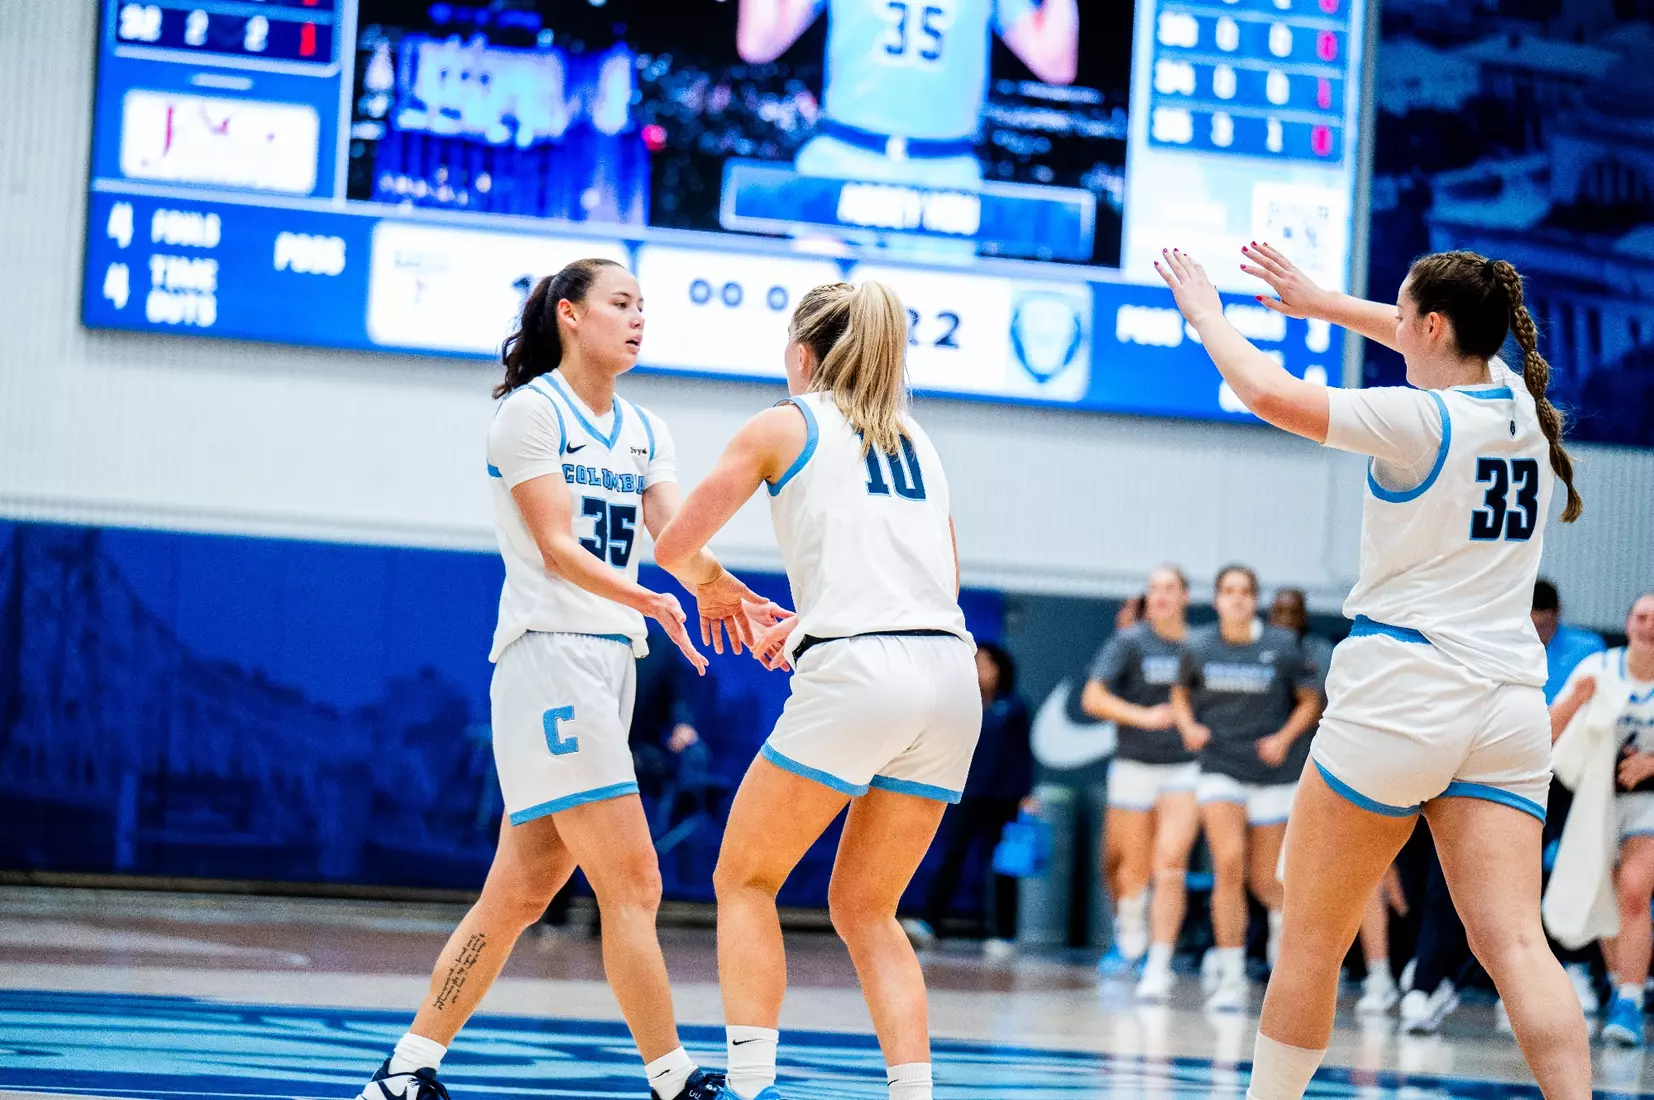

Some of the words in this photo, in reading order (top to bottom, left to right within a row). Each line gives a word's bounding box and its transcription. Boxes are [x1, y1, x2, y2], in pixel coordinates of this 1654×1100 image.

[884, 1, 945, 61] 35
[849, 422, 926, 502] 10
[1469, 456, 1539, 542] 33
[579, 495, 637, 569] 35
[543, 705, 580, 756] C
